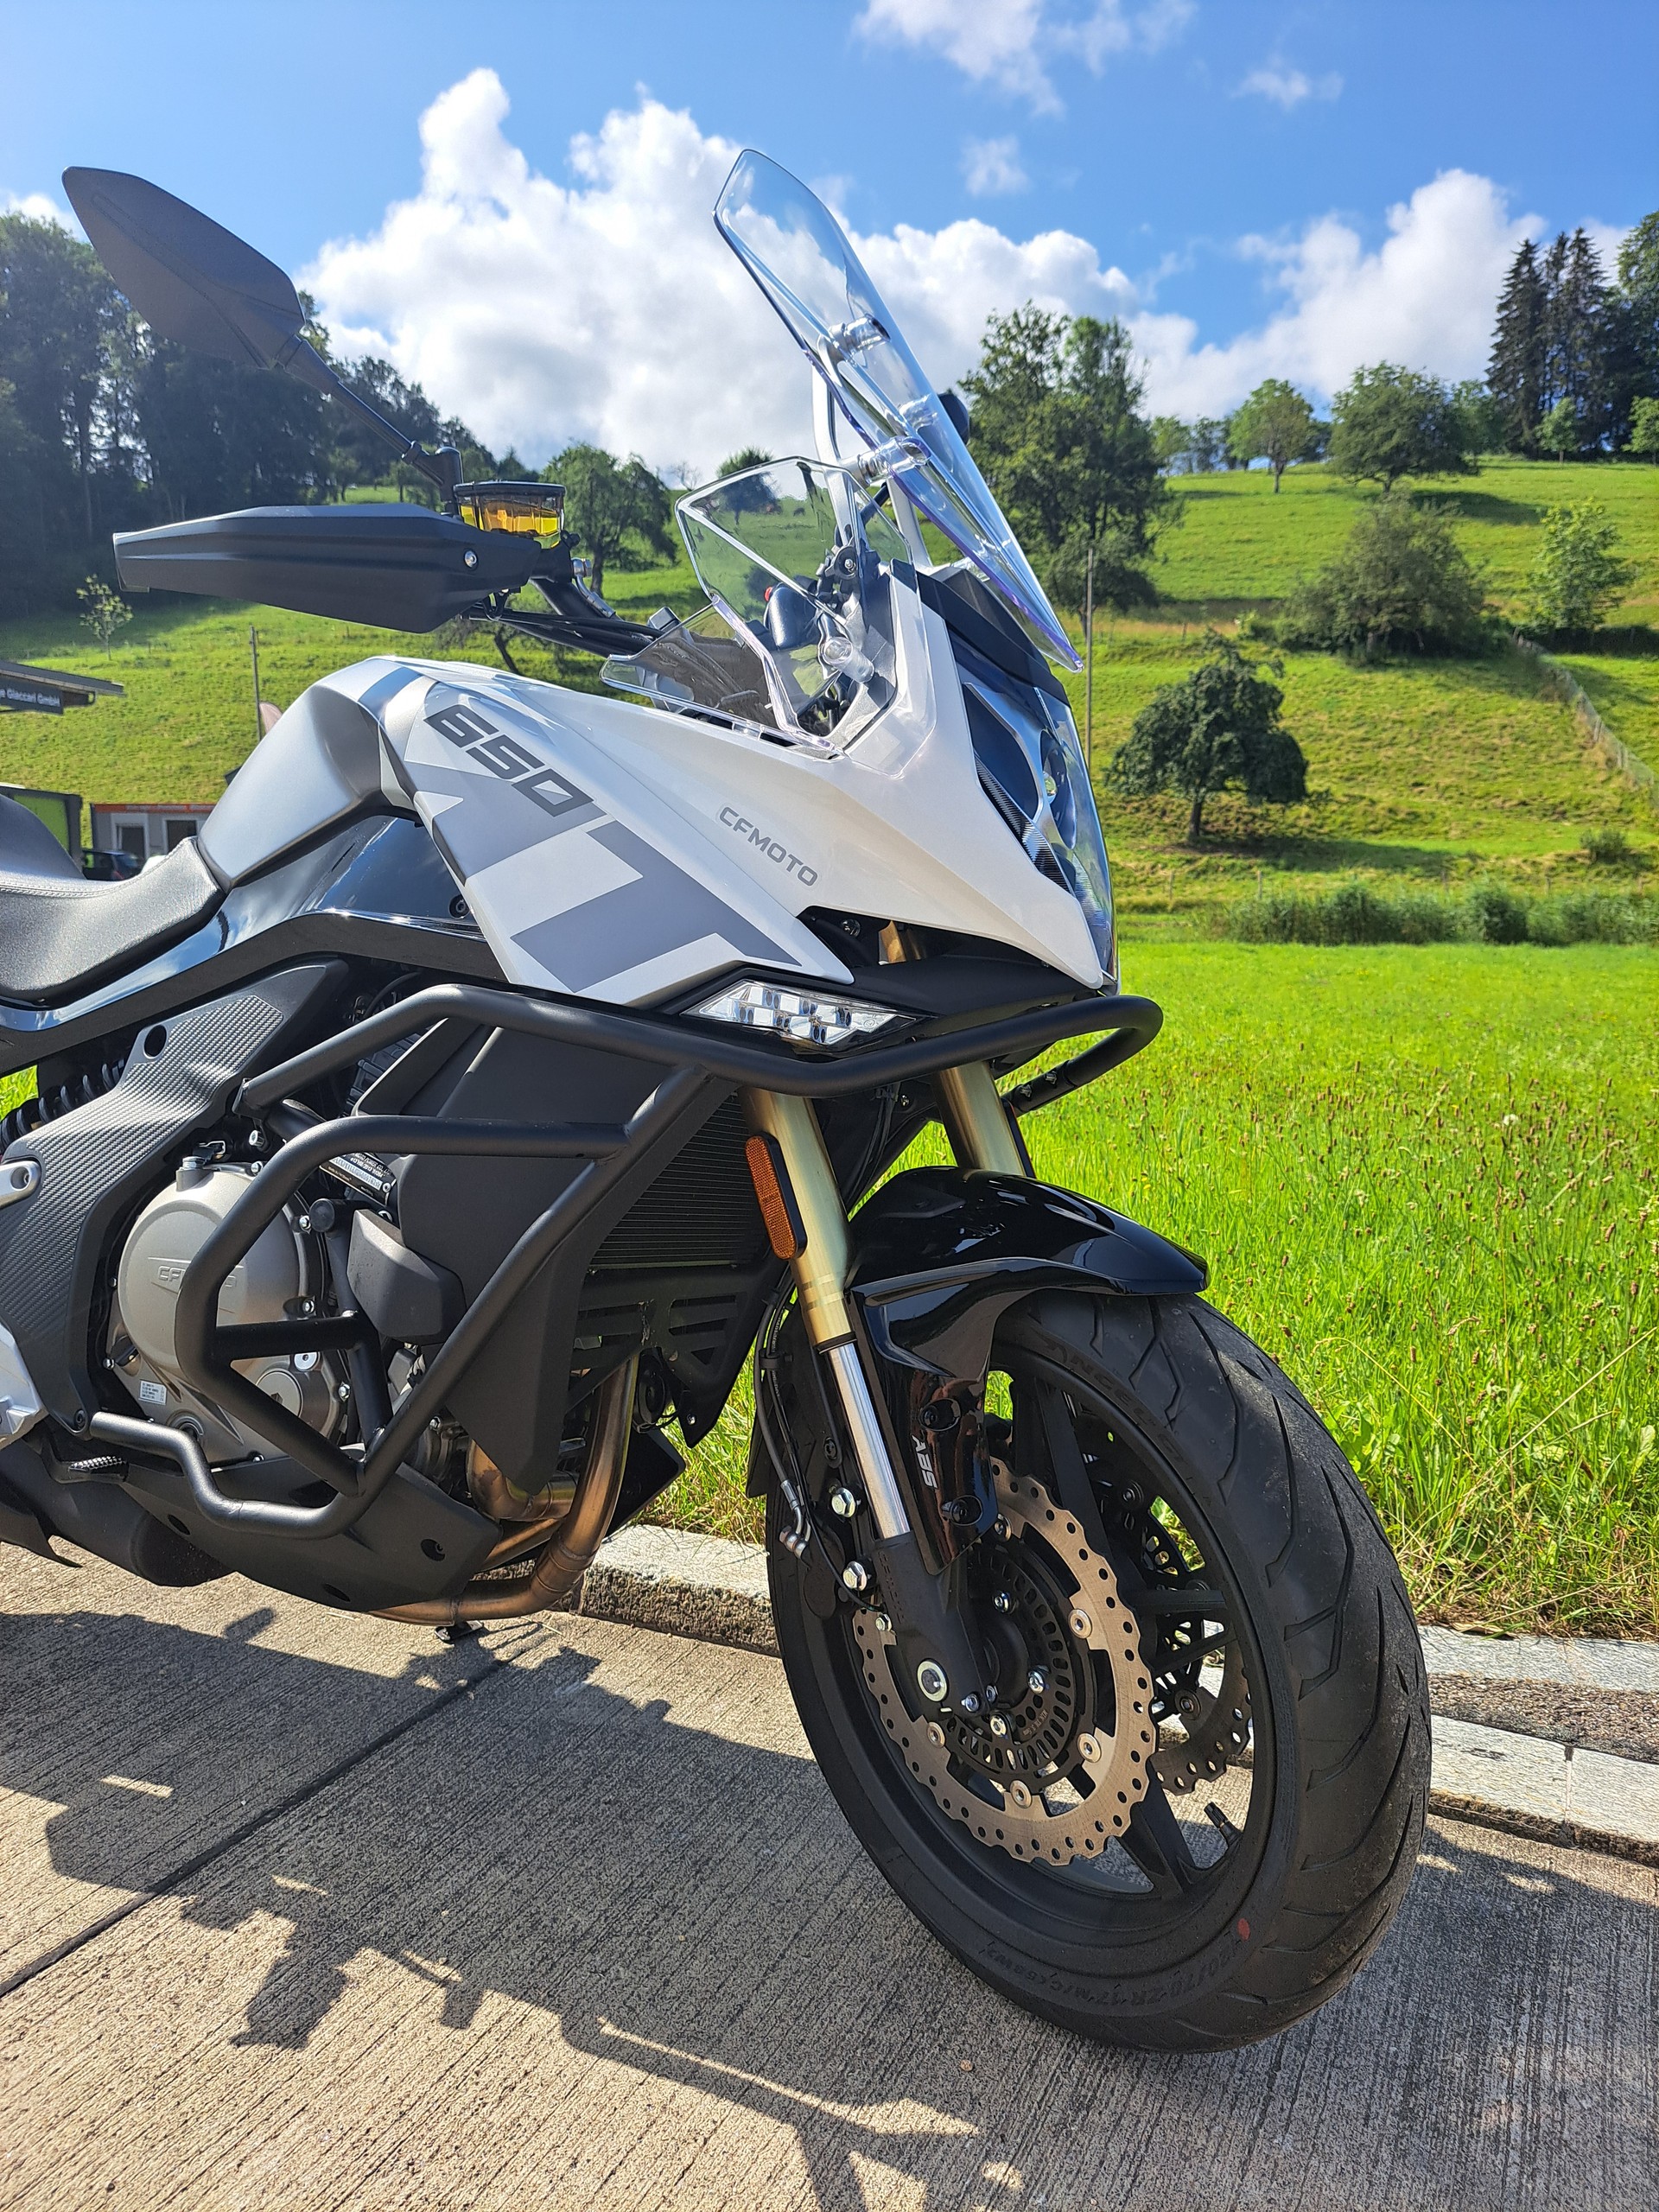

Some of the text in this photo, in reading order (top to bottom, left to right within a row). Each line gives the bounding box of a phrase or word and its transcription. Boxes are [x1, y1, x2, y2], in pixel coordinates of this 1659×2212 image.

[37, 692, 60, 707] GmbH
[423, 704, 594, 817] 650
[719, 806, 818, 887] CFMOTO
[911, 1434, 938, 1489] ABS
